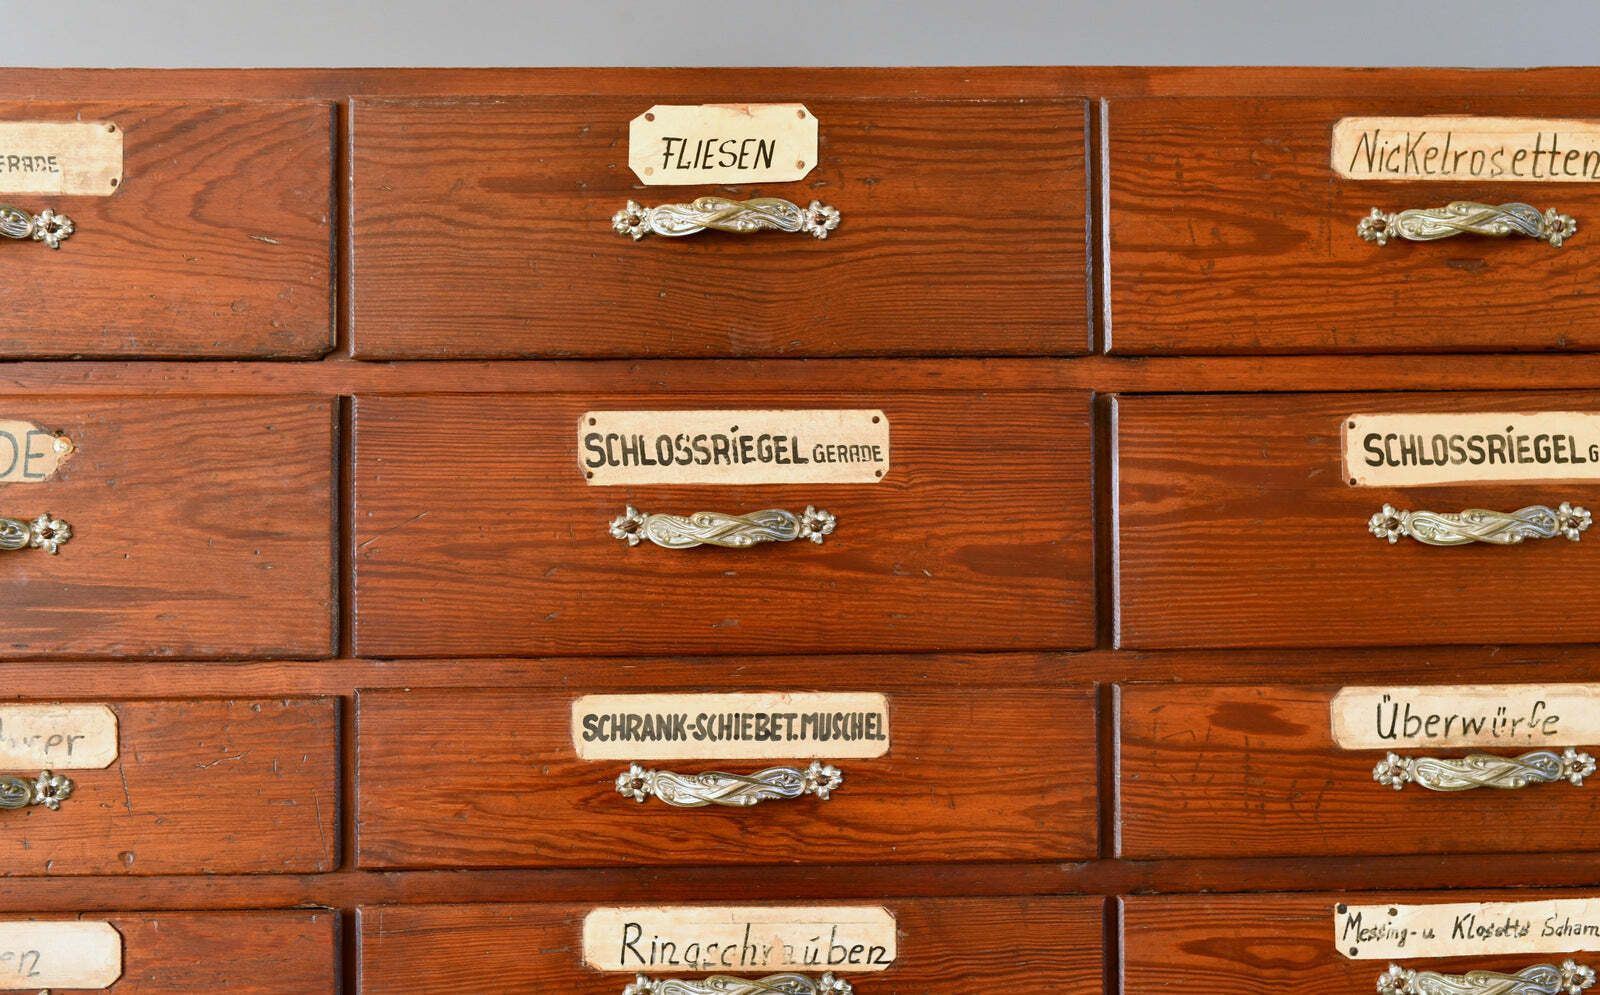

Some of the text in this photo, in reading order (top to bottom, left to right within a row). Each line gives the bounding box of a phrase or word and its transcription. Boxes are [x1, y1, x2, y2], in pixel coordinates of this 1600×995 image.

[661, 136, 776, 170] FLIESEN
[812, 443, 884, 463] GERADE
[1376, 694, 1560, 740] Überwürfe
